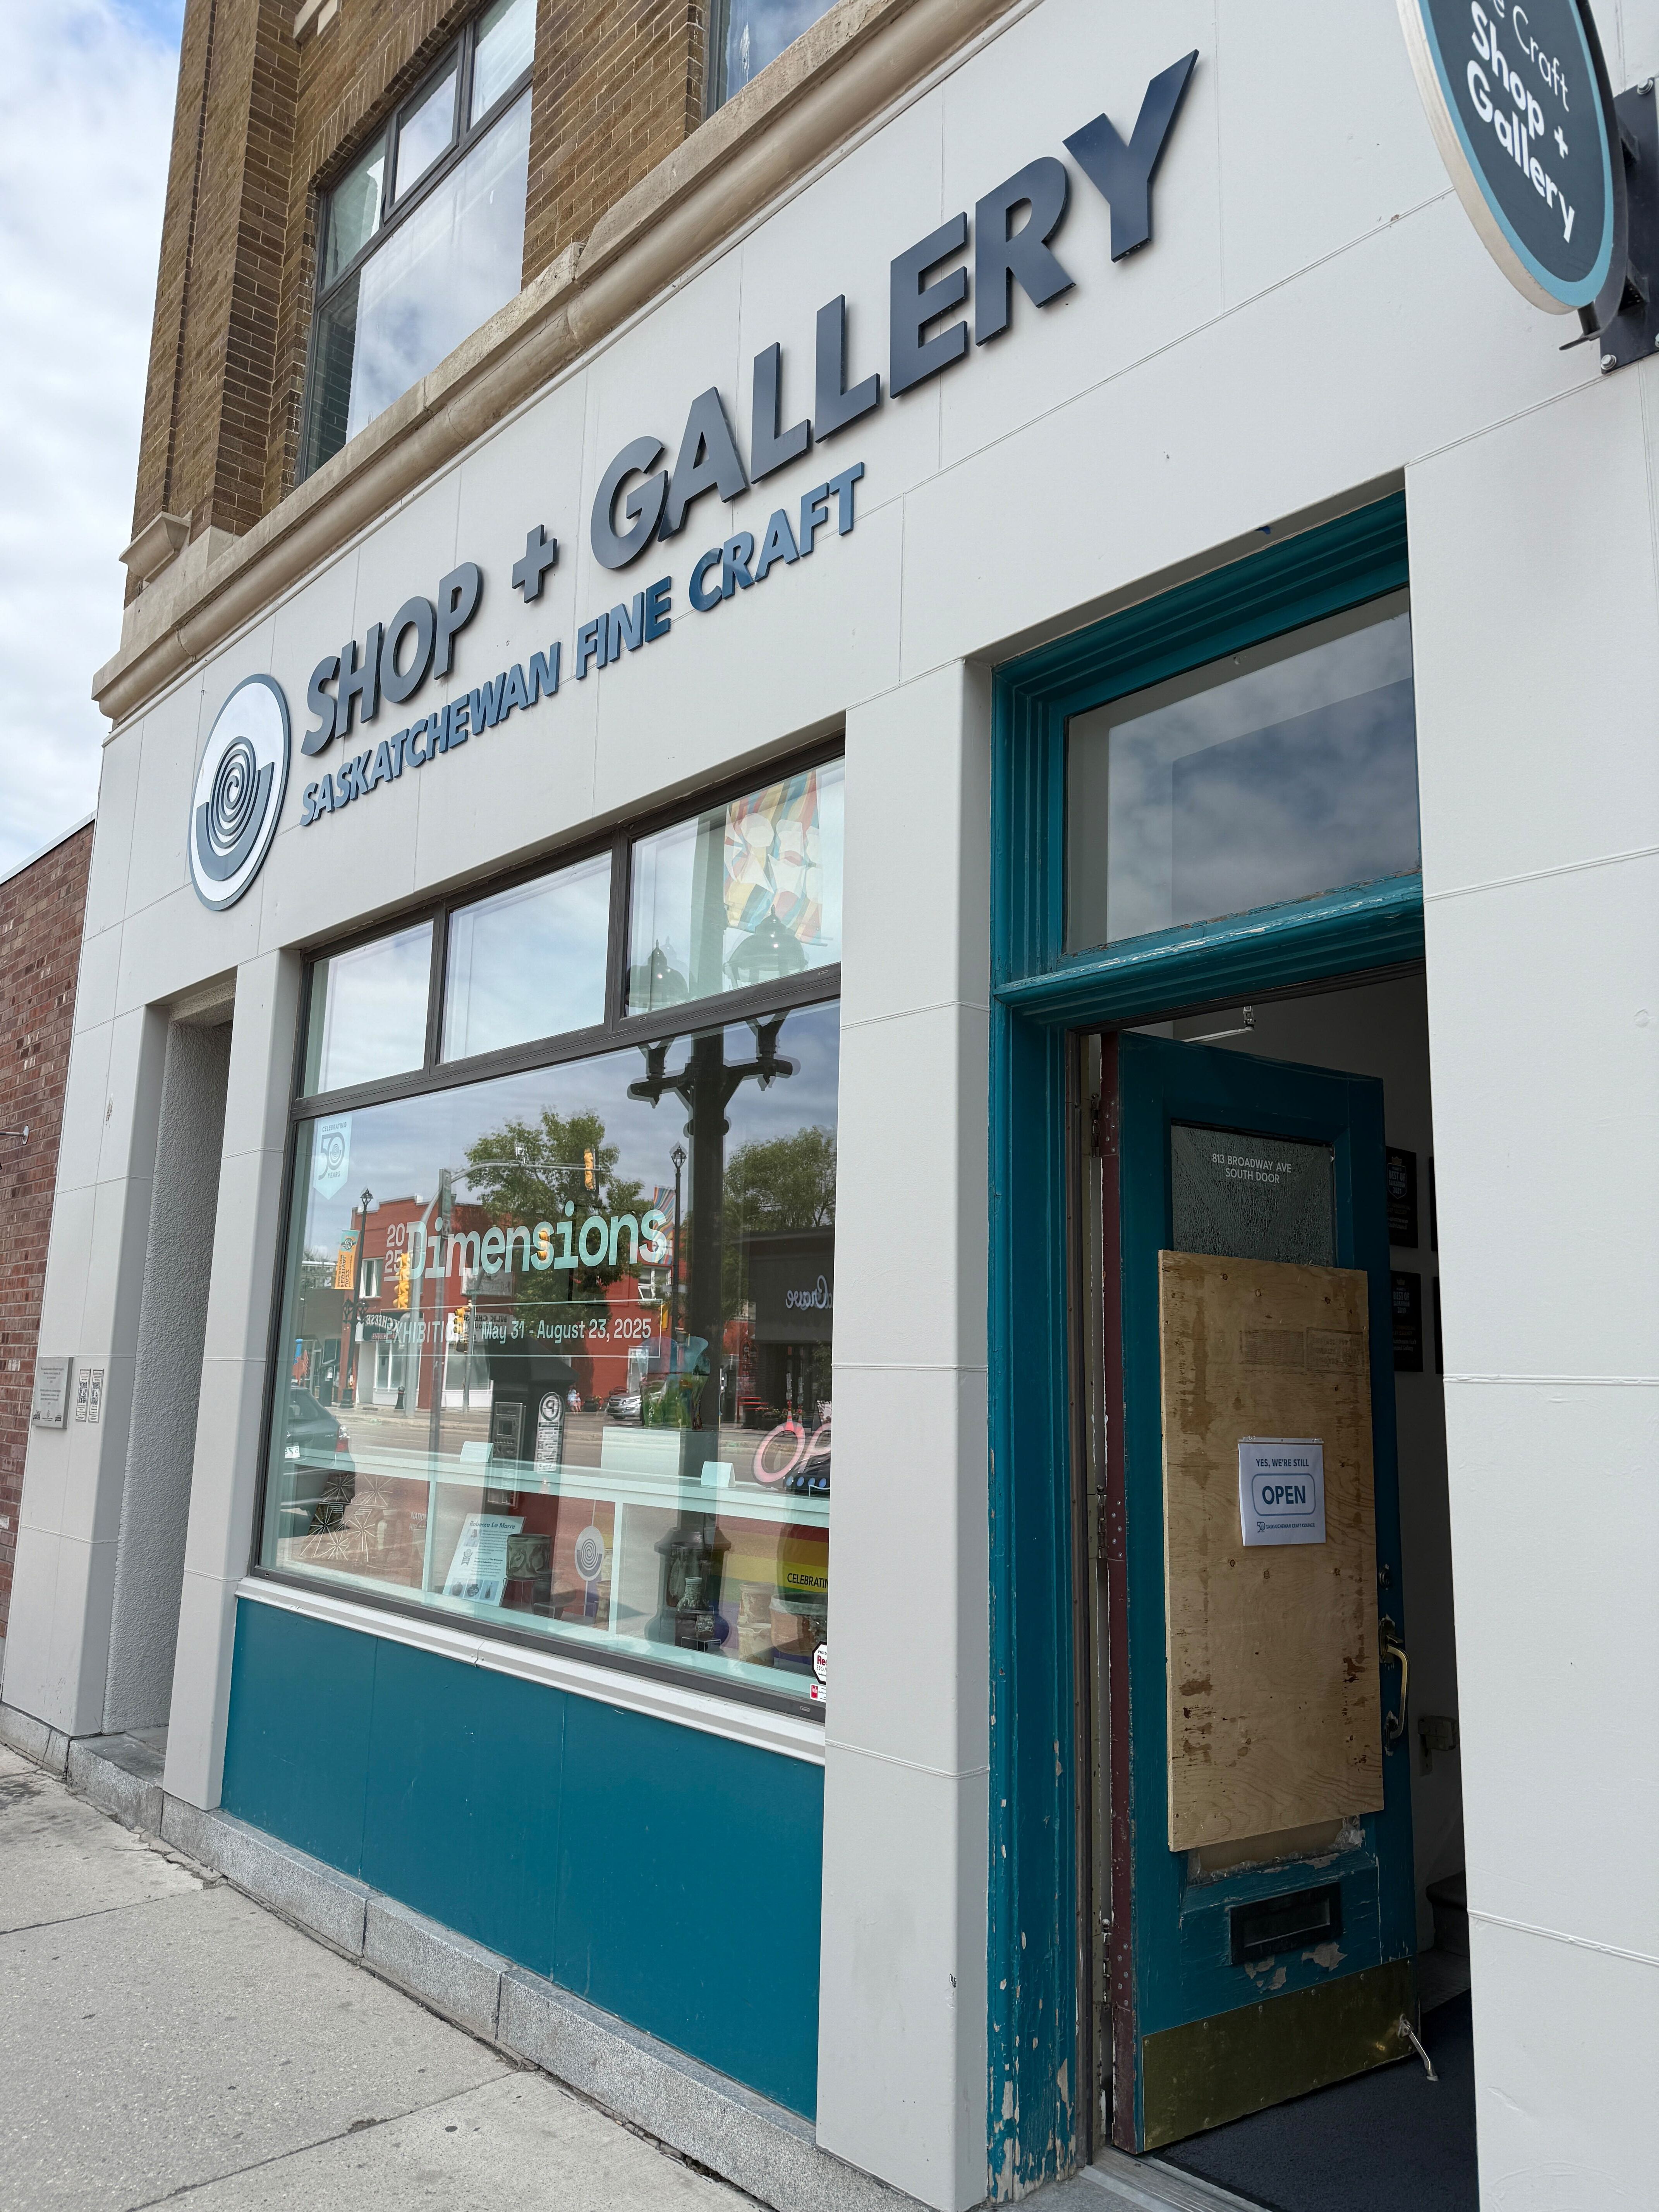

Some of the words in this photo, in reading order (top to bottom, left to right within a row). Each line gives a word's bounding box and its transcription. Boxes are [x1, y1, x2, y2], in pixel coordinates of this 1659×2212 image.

[1513, 6, 1570, 112] Craft
[1472, 4, 1545, 140] Shop
[1554, 126, 1568, 158] +
[1467, 60, 1575, 244] Gallery
[301, 561, 482, 756] SHOP
[512, 524, 557, 604] +
[590, 48, 1199, 570] GALLERY
[299, 641, 561, 826] SASKATCHEWAN
[576, 575, 671, 680] FINE
[688, 462, 865, 612] CRAFT
[322, 1122, 347, 1132] CELEBRATING
[318, 1132, 345, 1180] 50
[1212, 1153, 1224, 1164] 813
[1228, 1155, 1273, 1170] BROADWAY
[1276, 1162, 1292, 1173] AVE
[1225, 1168, 1253, 1180] SOUTH
[1256, 1171, 1280, 1184] DOOR
[386, 1223, 405, 1247] 20
[406, 1200, 667, 1279] Dimensions
[481, 1321, 507, 1344] May
[511, 1321, 524, 1340] 31
[537, 1319, 585, 1344] August
[589, 1319, 611, 1341] 23,
[615, 1318, 651, 1339] 2025
[1256, 1459, 1270, 1468] YES,
[1272, 1459, 1291, 1467] WE'RE
[1293, 1459, 1309, 1467] STILL
[1262, 1485, 1306, 1505] OPEN
[817, 1655, 827, 1666] Re
